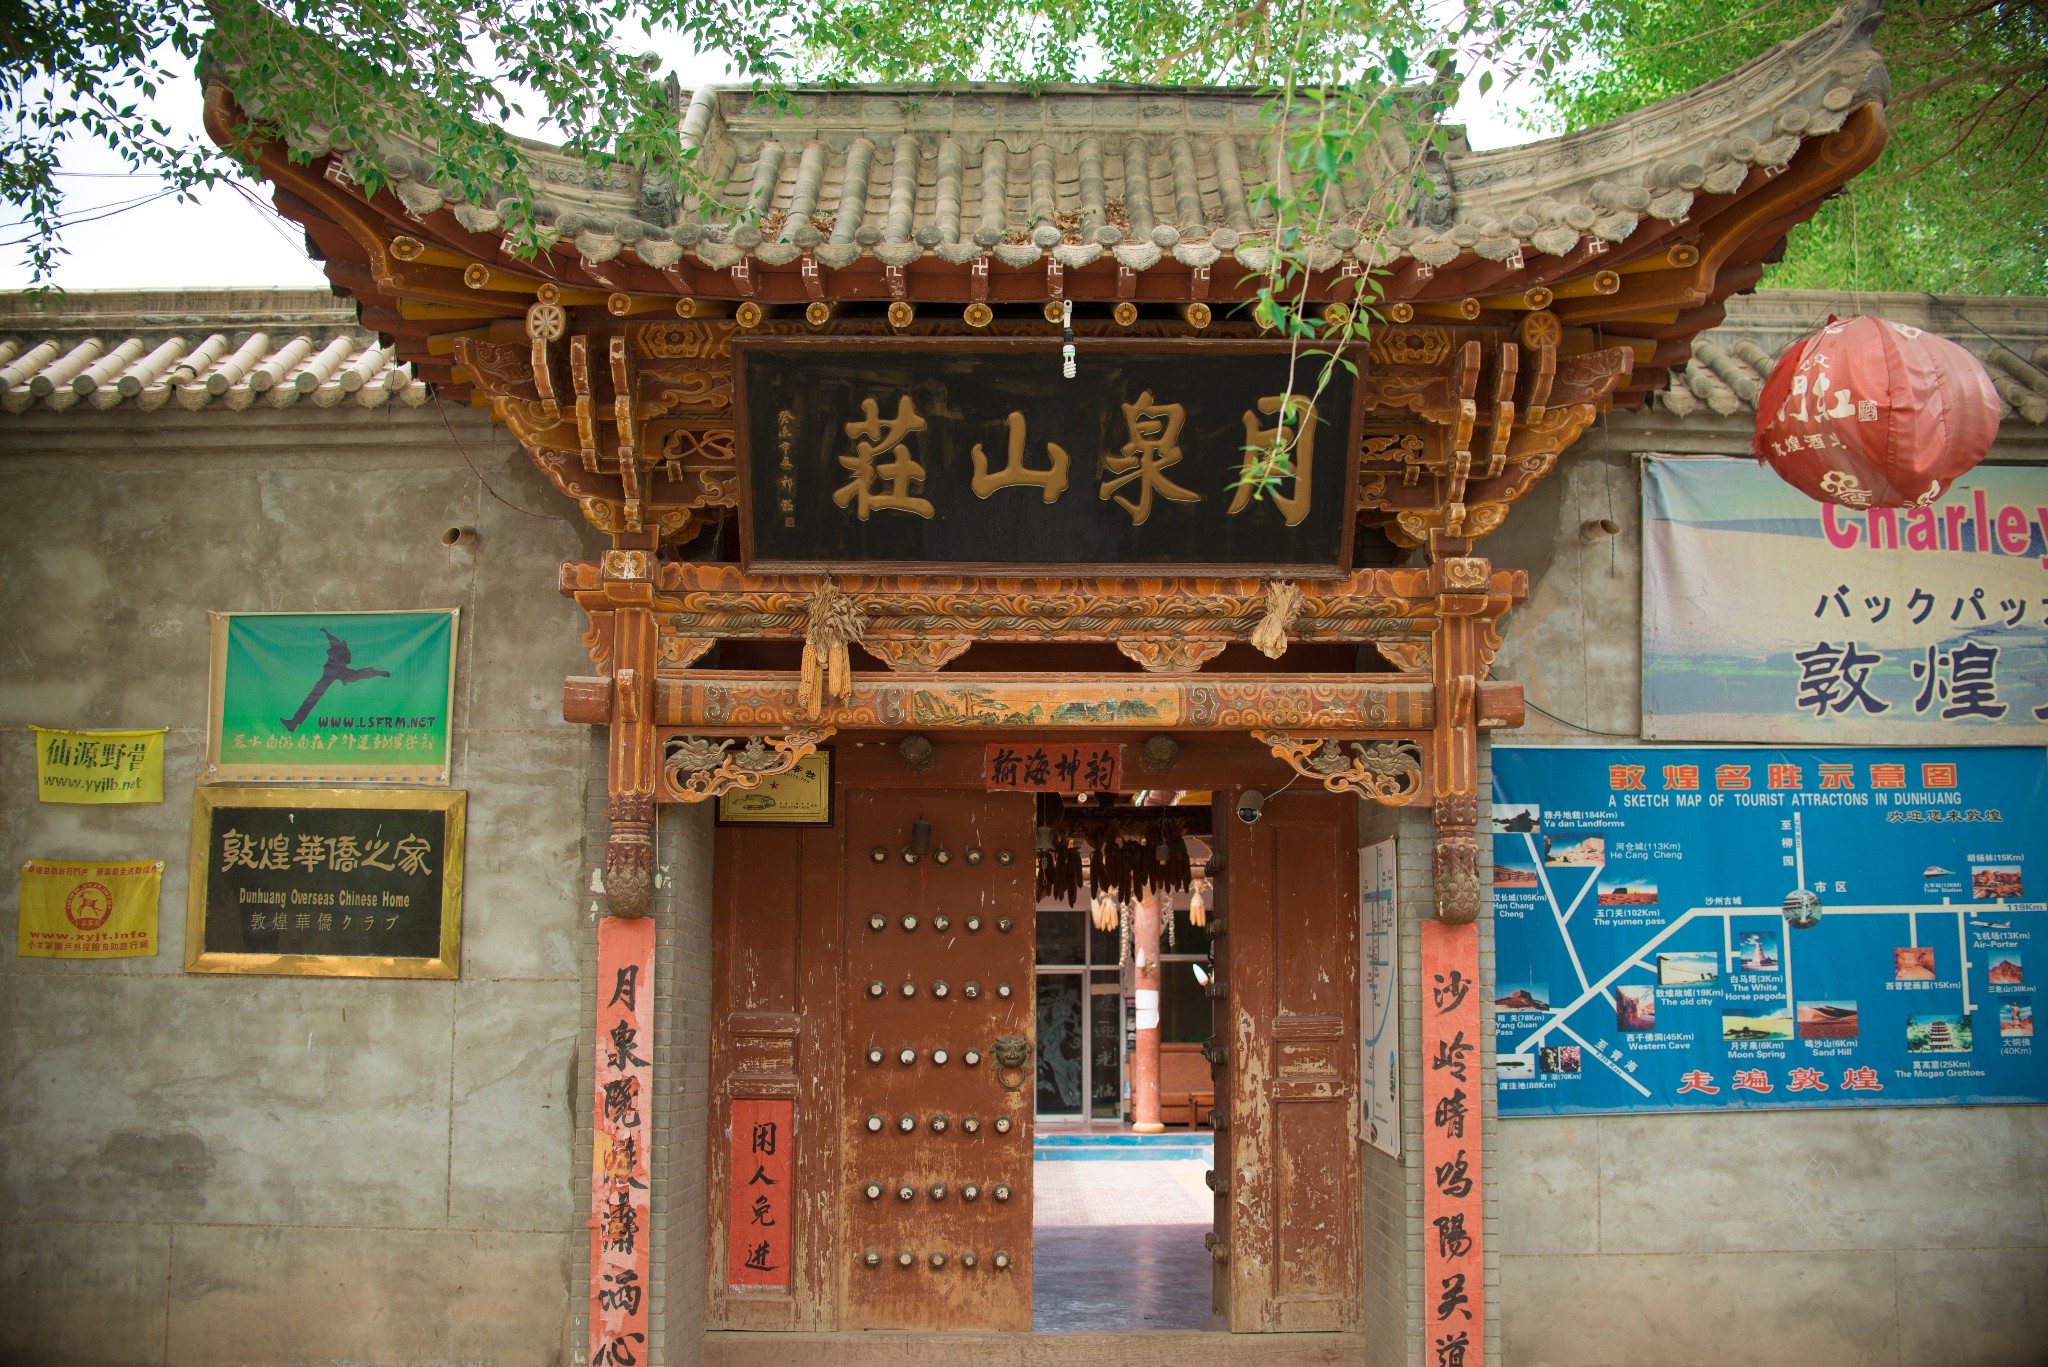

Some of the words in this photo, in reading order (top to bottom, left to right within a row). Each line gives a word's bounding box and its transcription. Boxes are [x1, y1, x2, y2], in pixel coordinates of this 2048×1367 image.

[1821, 490, 2048, 571] Charle
[1795, 641, 2048, 720] 敦煌
[1609, 763, 1957, 790] 敦煌名胜示意图
[1608, 795, 1617, 807] A
[1623, 794, 1669, 807] SKETCH
[1676, 794, 1702, 807] MAP
[1709, 794, 1724, 807] OF
[1735, 793, 1784, 807] TOURIST
[1792, 793, 1868, 806] ATTRACTONS
[1876, 793, 1887, 805] IN
[1894, 792, 1961, 805] DUNHUANG
[1543, 820, 1555, 828] Ya
[1558, 820, 1575, 828] dan
[1577, 819, 1625, 828] Landforms
[221, 828, 433, 876] 敦煌華僑之家
[1625, 851, 1648, 860] Cang
[1653, 851, 1682, 860] Cheng
[1814, 881, 1847, 893] 市区
[239, 888, 287, 908] Dunhuang
[291, 888, 335, 906] Overseas
[339, 889, 378, 907] Chinese
[382, 891, 410, 908] Home
[1493, 902, 1509, 910] Han
[1511, 902, 1534, 911] Chang
[2006, 903, 2043, 911] 119Km
[1499, 910, 1524, 918] Cheng
[250, 911, 399, 931] 敦煌華僑クラブ
[1612, 919, 1642, 927] yumen
[1645, 919, 1666, 927] pass
[30, 930, 147, 942] www.xyjt.info
[1661, 998, 1676, 1006] The
[1678, 998, 1693, 1006] old
[1696, 998, 1713, 1006] city
[1725, 992, 1751, 1001] Horse
[1753, 993, 1786, 1002] pagoda
[1495, 1022, 1516, 1030] Yang
[1518, 1021, 1538, 1029] Guan
[1628, 1042, 1666, 1050] Western
[1669, 1042, 1690, 1050] Cave
[1756, 1050, 1786, 1059] Spring
[1812, 1048, 1835, 1056] Sand
[1838, 1048, 1852, 1056] Hill
[1895, 1070, 1912, 1078] The
[1914, 1070, 1944, 1079] Mogao
[1946, 1069, 1986, 1077] Grottoes
[1677, 1066, 1883, 1095] 走遍敦煌
